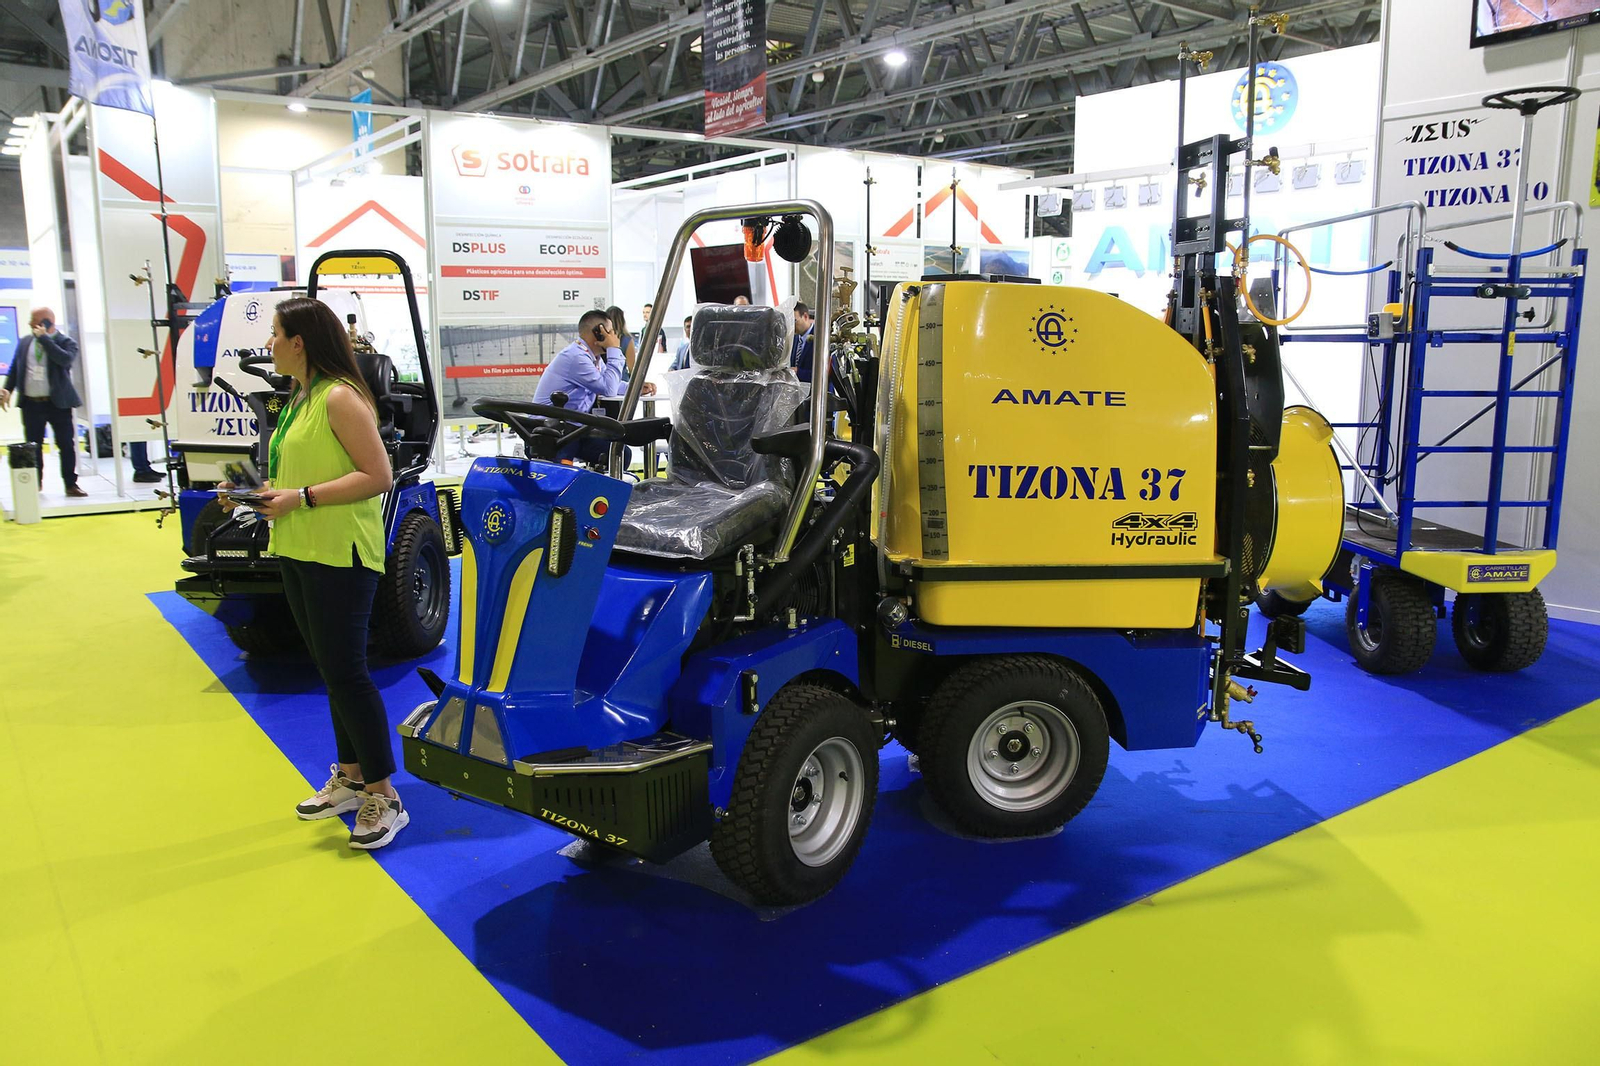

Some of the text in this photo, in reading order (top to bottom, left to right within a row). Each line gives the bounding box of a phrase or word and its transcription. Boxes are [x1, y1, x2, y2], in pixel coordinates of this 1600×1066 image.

[497, 150, 589, 176] sotrafa
[1404, 152, 1489, 176] TIZONA
[1424, 184, 1510, 208] TIZONA
[452, 242, 506, 254] DSPLUS
[540, 244, 600, 256] ECOPLUS
[463, 290, 499, 300] DSTIF
[563, 290, 580, 300] BF
[188, 392, 254, 412] TIZON
[992, 388, 1126, 406] AMATE
[483, 466, 547, 481] TIZONA 37
[968, 465, 1186, 502] TIZONA 37
[1112, 512, 1198, 532] 4x4
[1111, 532, 1198, 548] Hydraulic
[904, 639, 933, 652] DIESEL
[541, 808, 628, 846] TIZONA 37
